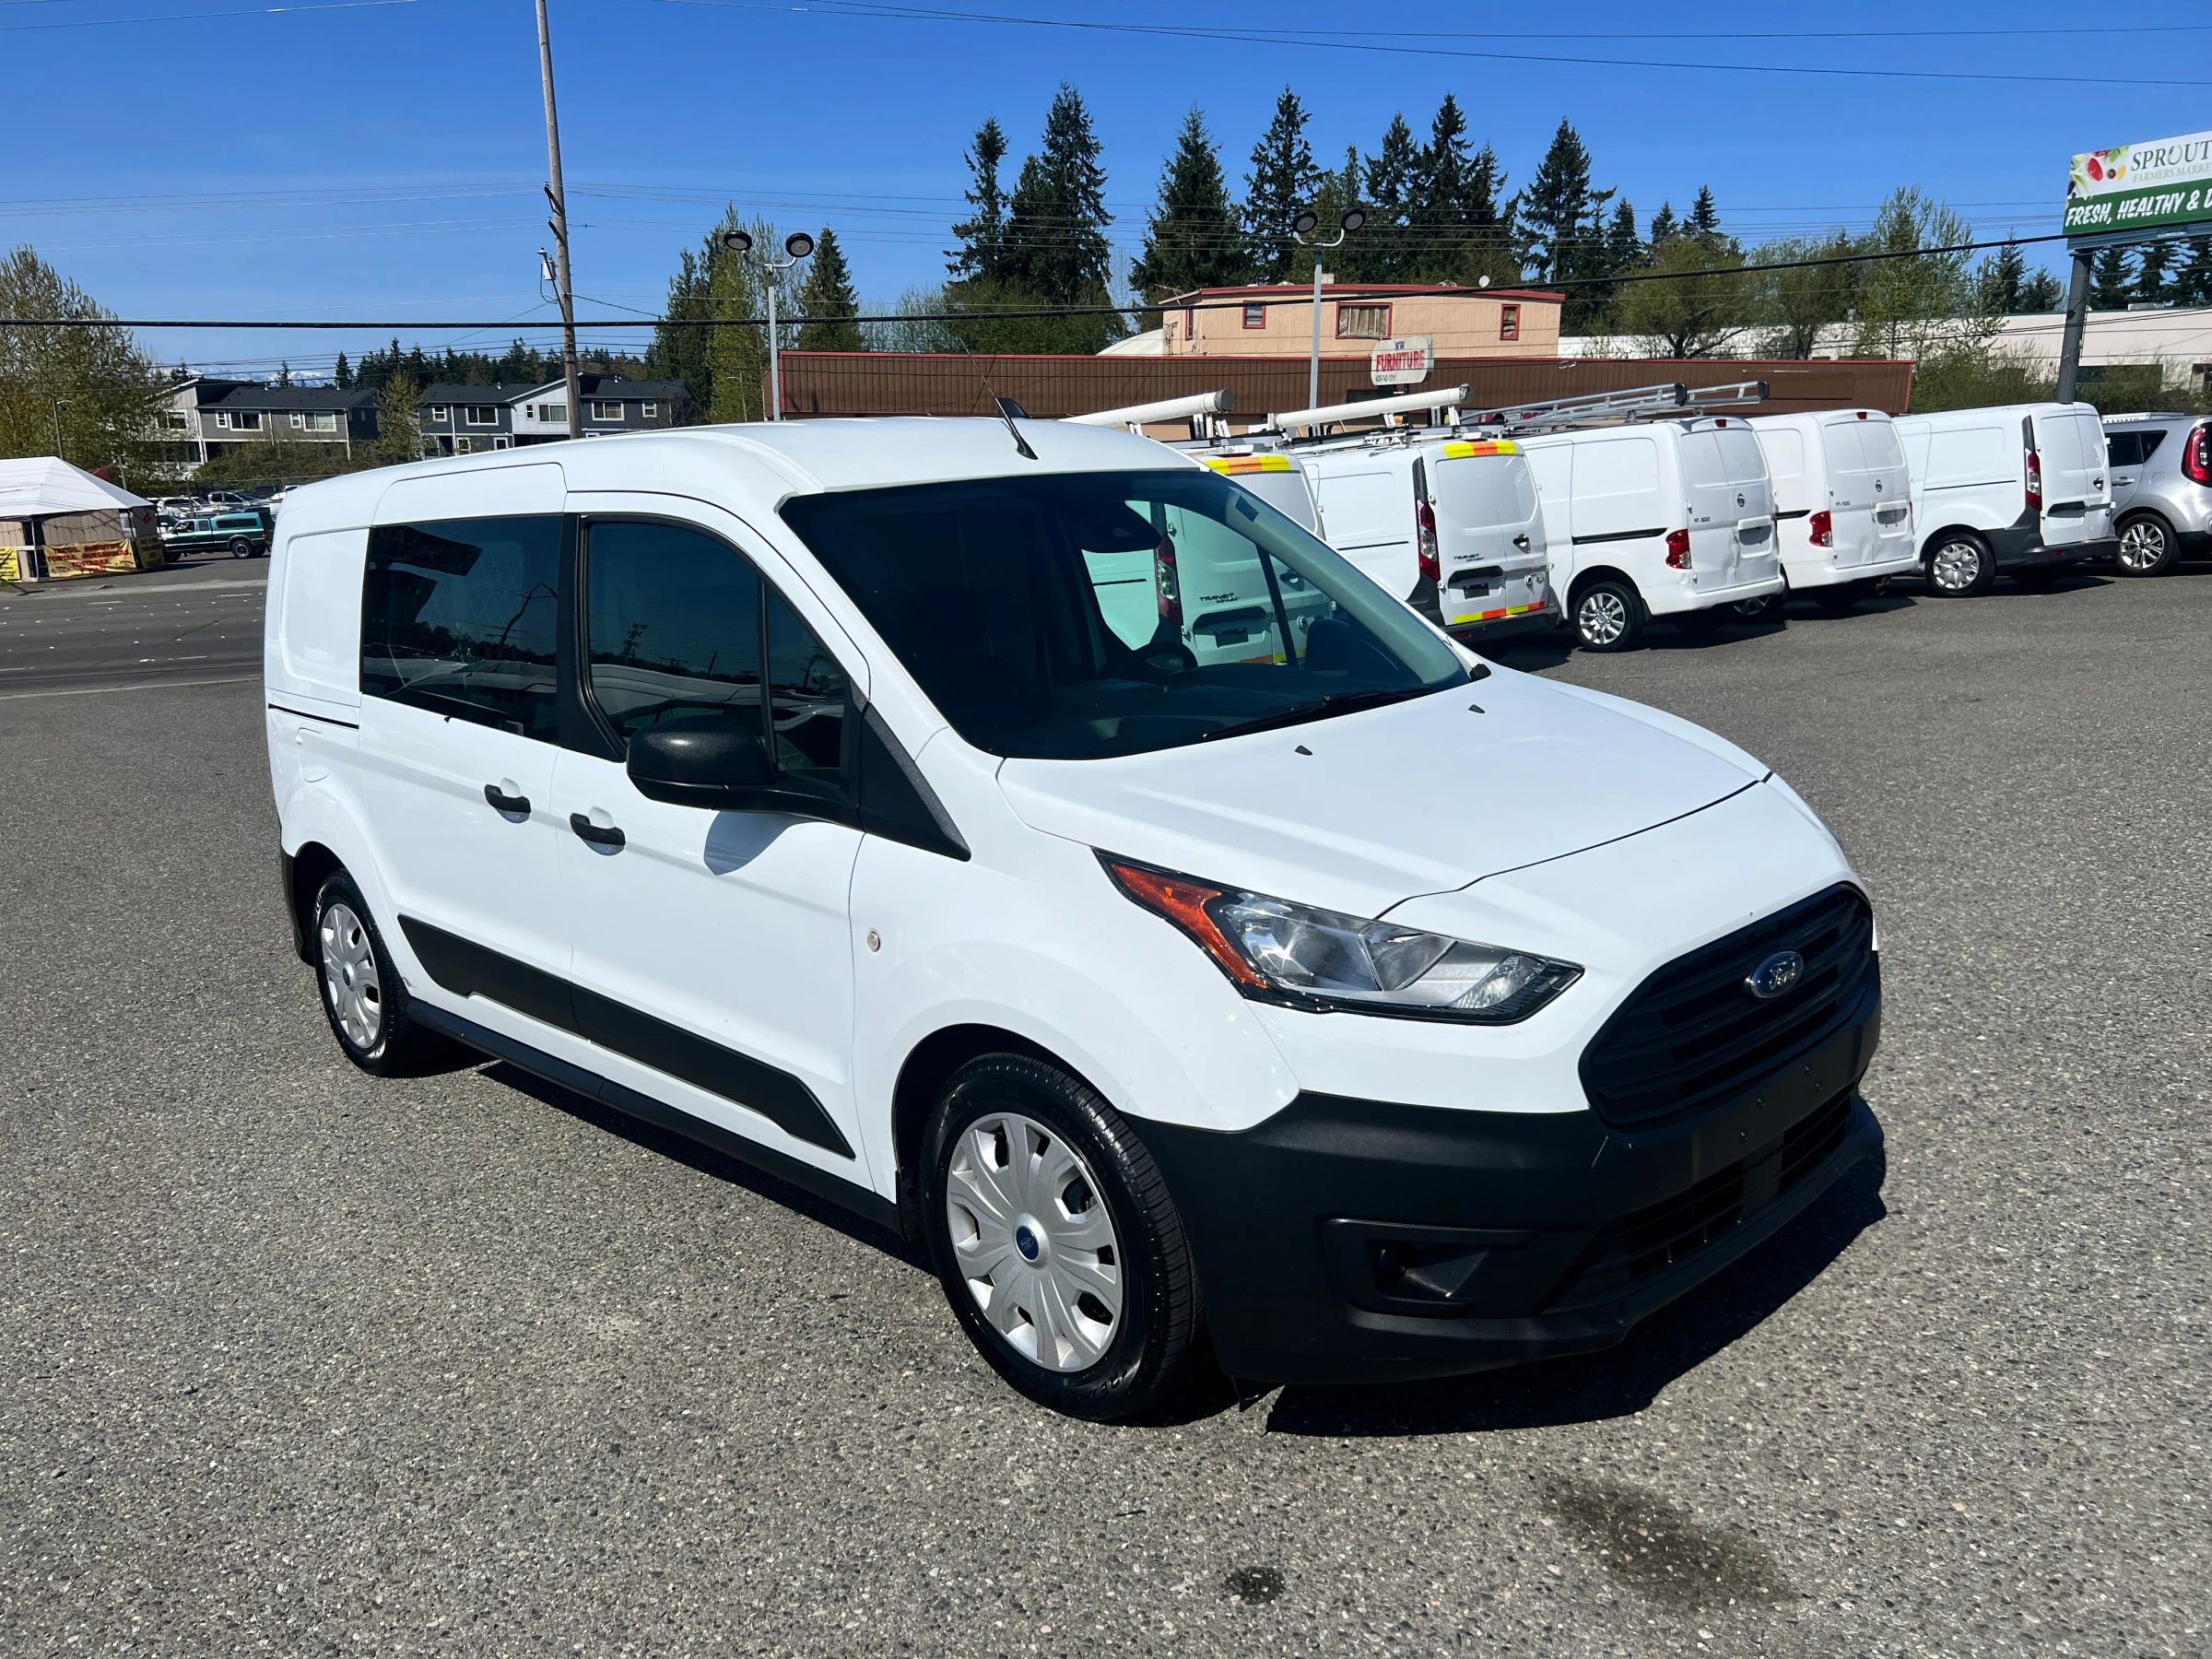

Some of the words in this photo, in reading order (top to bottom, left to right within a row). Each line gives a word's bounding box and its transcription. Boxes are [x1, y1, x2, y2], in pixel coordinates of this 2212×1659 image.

[2133, 168, 2175, 183] FARMERS
[2065, 202, 2112, 227] FRESH,
[2117, 192, 2185, 220] HEALTHY
[2186, 189, 2201, 211] &
[1376, 350, 1425, 371] FURNITURE
